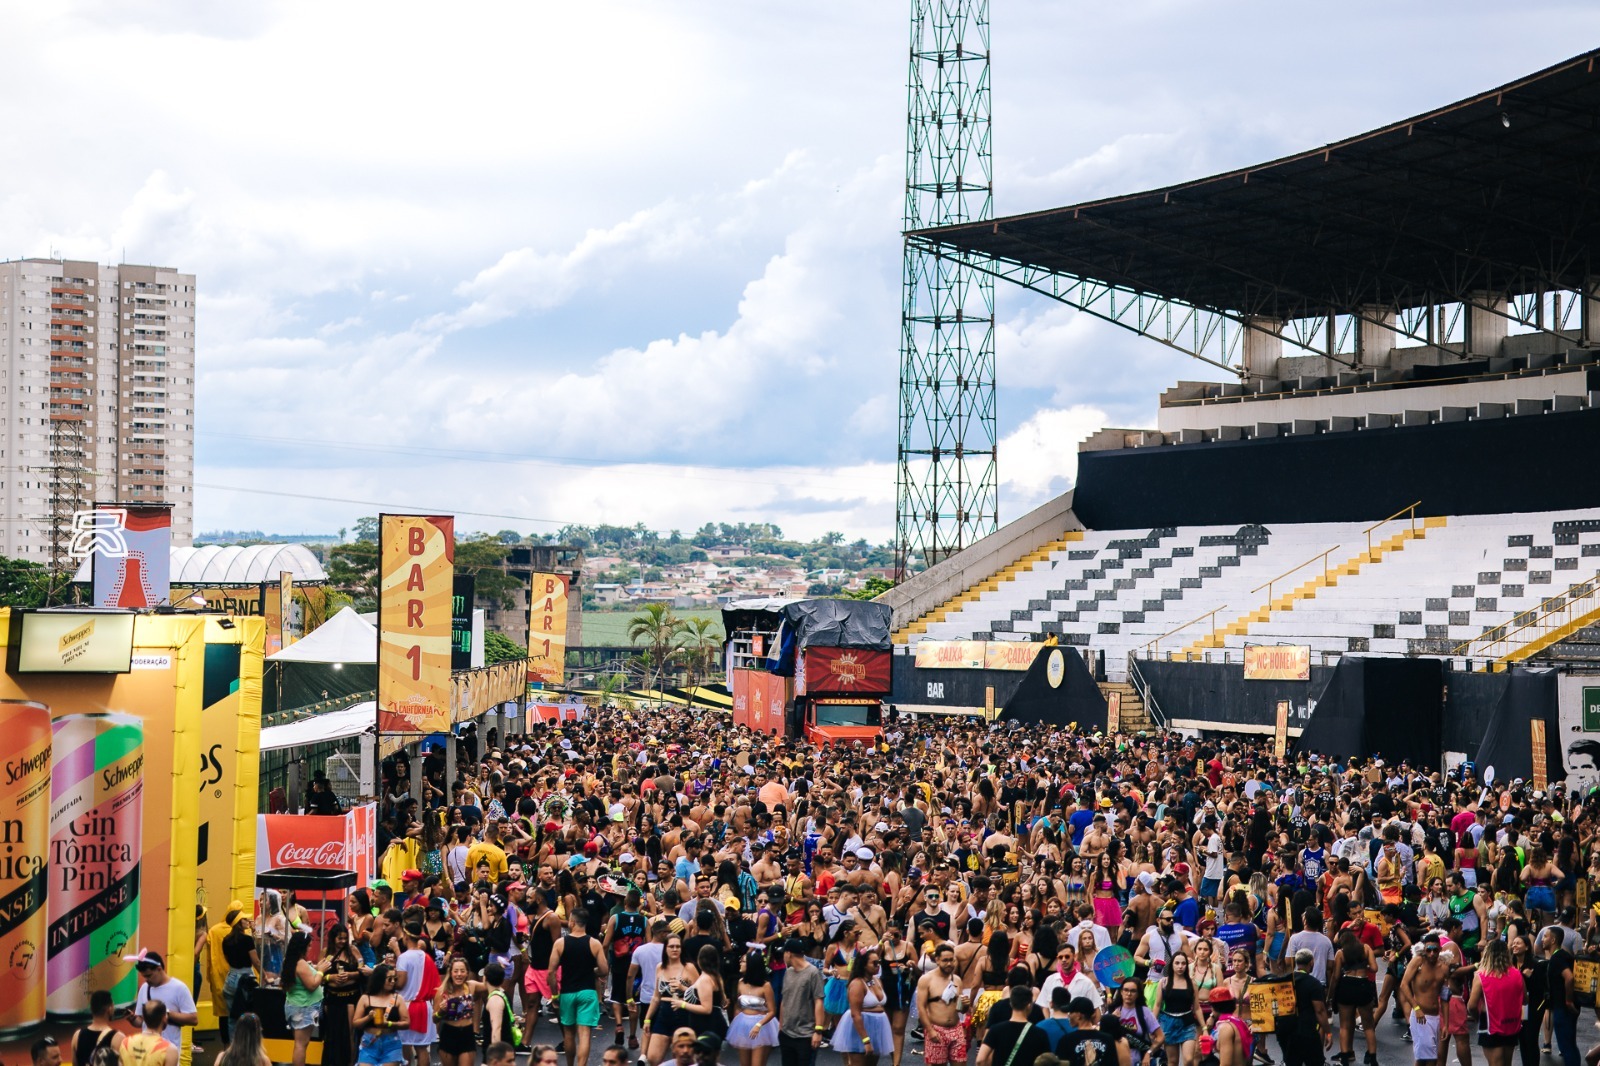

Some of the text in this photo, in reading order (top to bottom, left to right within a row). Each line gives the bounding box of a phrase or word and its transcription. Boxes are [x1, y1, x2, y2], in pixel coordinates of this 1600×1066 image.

[406, 526, 426, 682] BAR 1
[543, 578, 555, 631] BAR
[938, 646, 963, 662] CAIXA
[1007, 647, 1031, 664] CAIXA
[1256, 652, 1297, 669] WC HOMEM
[927, 682, 945, 699] BAR
[69, 809, 116, 837] Gin
[1291, 816, 1308, 826] CAIXA
[51, 836, 132, 865] Tônica
[61, 863, 121, 892] Pink
[52, 883, 128, 947] INTENSE
[1094, 952, 1130, 971] CAIXA
